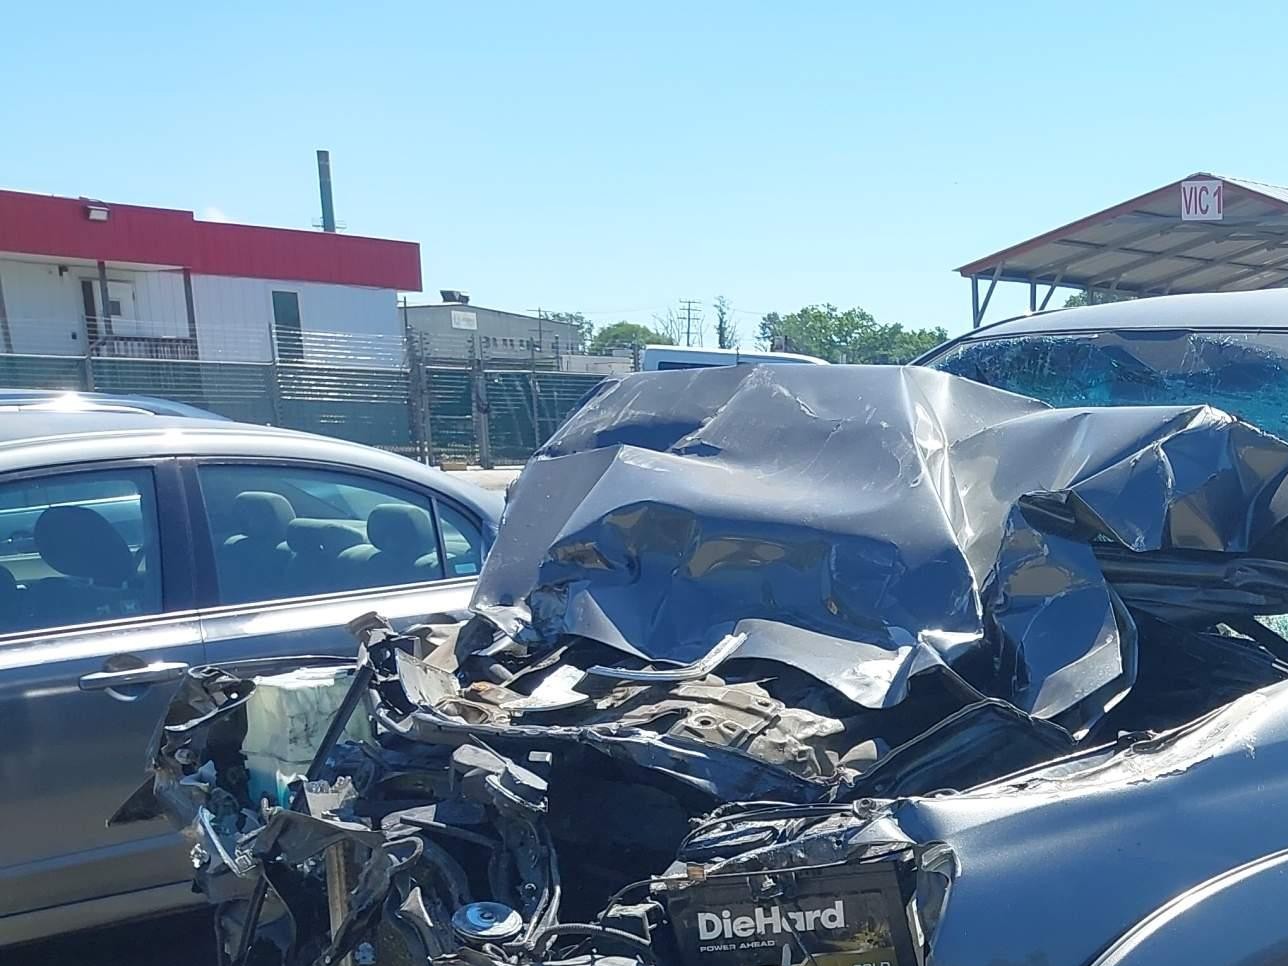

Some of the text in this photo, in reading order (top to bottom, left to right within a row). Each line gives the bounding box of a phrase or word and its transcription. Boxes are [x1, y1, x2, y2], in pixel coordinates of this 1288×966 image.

[1182, 185, 1222, 215] VIC 1
[697, 900, 846, 940] DieHard
[700, 940, 775, 952] POWER AHEAD
